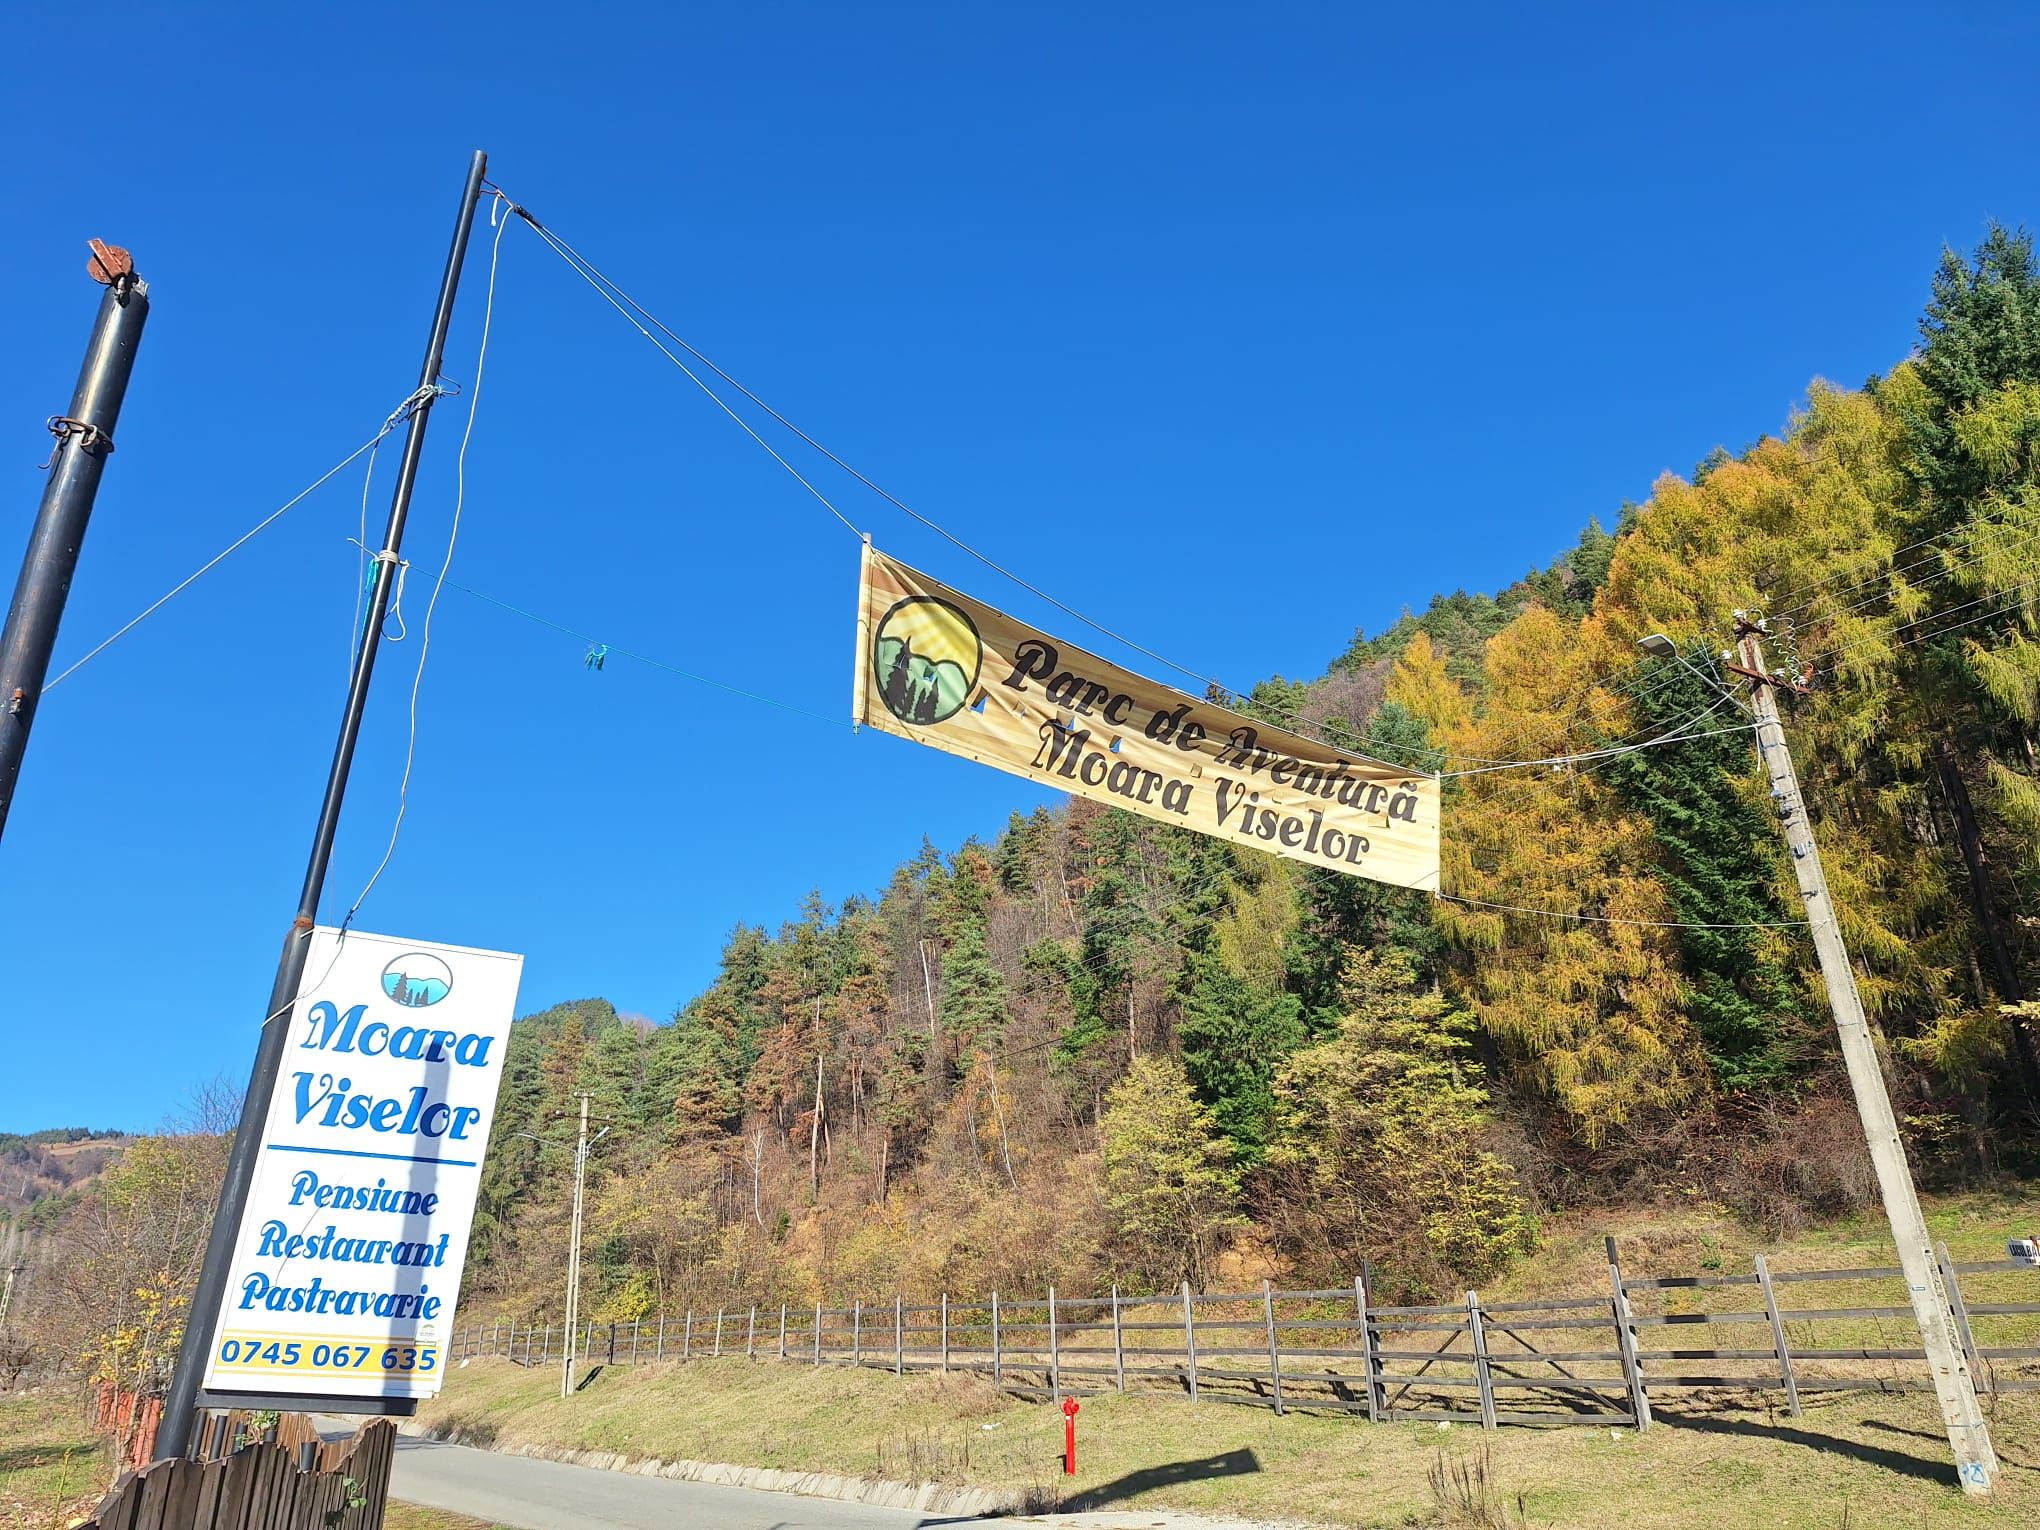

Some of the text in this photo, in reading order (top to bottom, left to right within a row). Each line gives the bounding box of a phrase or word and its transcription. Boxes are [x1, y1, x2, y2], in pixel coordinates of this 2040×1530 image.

[1002, 640, 1135, 726] Parc
[1145, 703, 1206, 751] de
[1031, 718, 1370, 866] Moara Viselor
[300, 1000, 494, 1067] Moara
[293, 1071, 480, 1140] Viselor
[288, 1170, 439, 1216] Pensiune
[256, 1219, 449, 1268] Restaurant
[238, 1271, 441, 1321] Pastravarie
[221, 1340, 436, 1372] 0745 067 635
